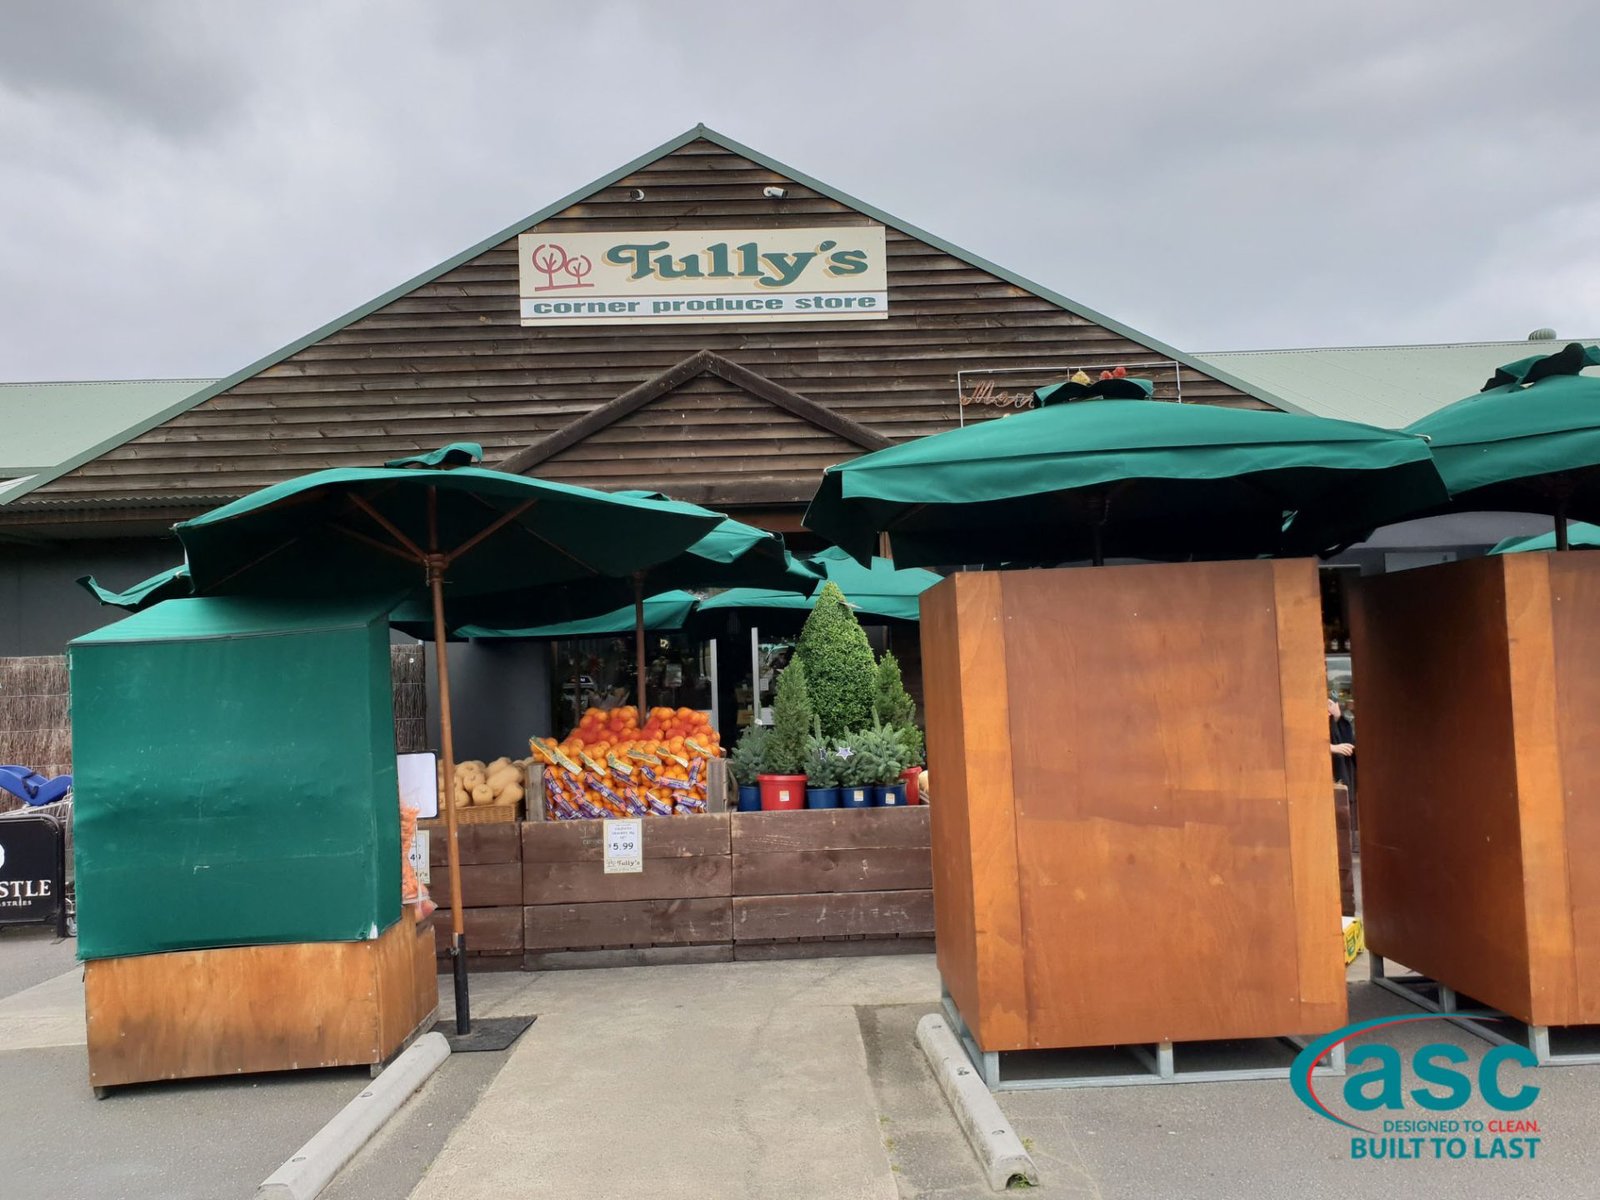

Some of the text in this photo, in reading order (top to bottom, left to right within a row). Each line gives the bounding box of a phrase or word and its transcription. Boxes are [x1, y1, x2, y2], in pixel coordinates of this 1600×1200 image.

[603, 240, 868, 288] Tully's
[534, 295, 876, 314] corner produce store
